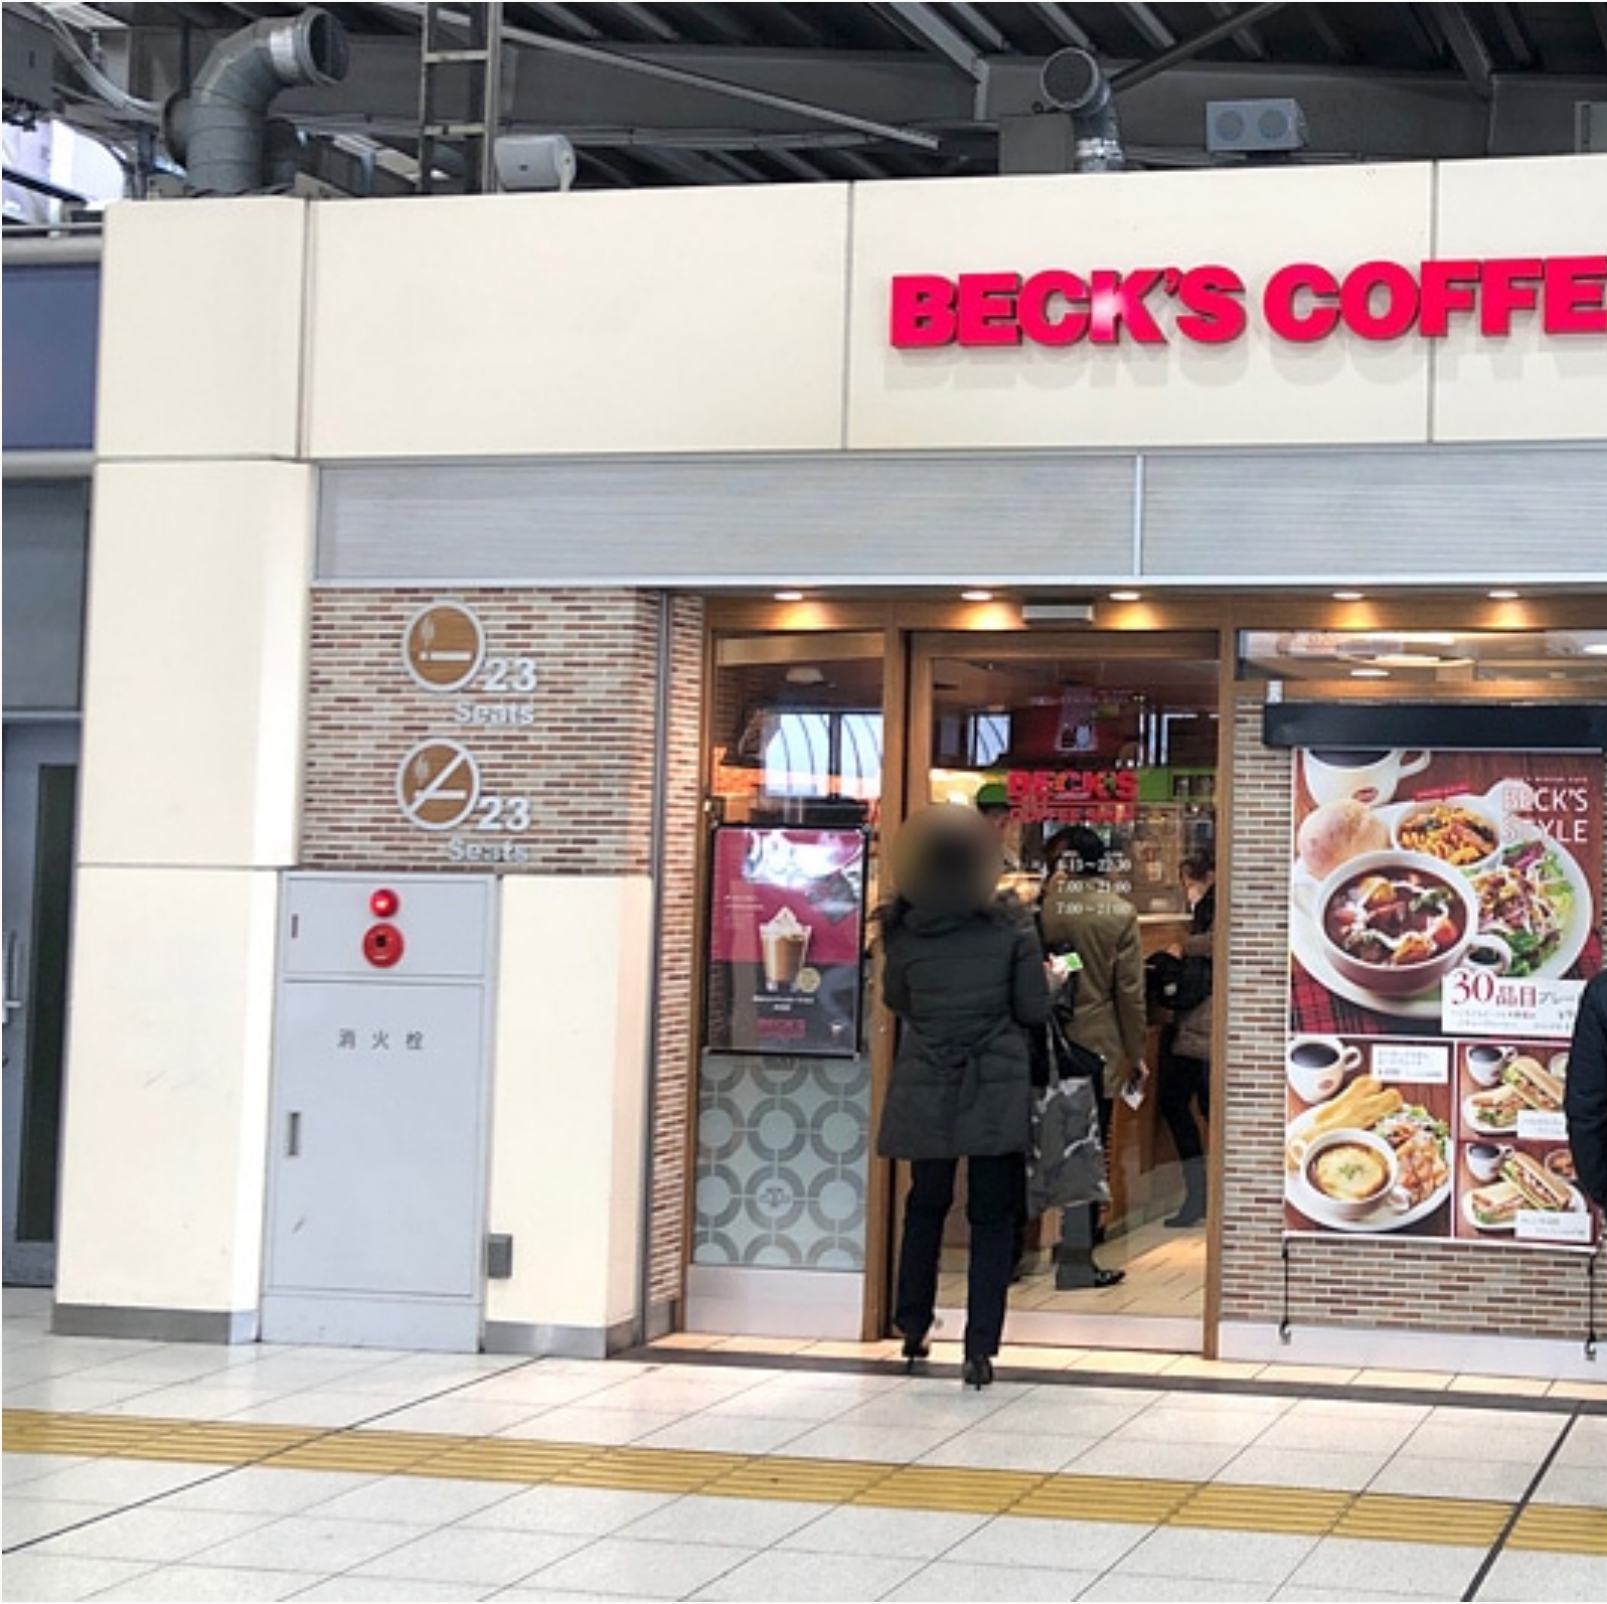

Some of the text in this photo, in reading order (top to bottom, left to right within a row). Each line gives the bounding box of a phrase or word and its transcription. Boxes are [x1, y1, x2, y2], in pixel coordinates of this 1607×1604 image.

[890, 264, 1246, 348] BECK'S
[484, 657, 538, 692] 23
[453, 701, 535, 725] Seats
[475, 796, 532, 831] 23
[446, 838, 530, 863] Seats
[337, 1028, 425, 1051] 消火栓
